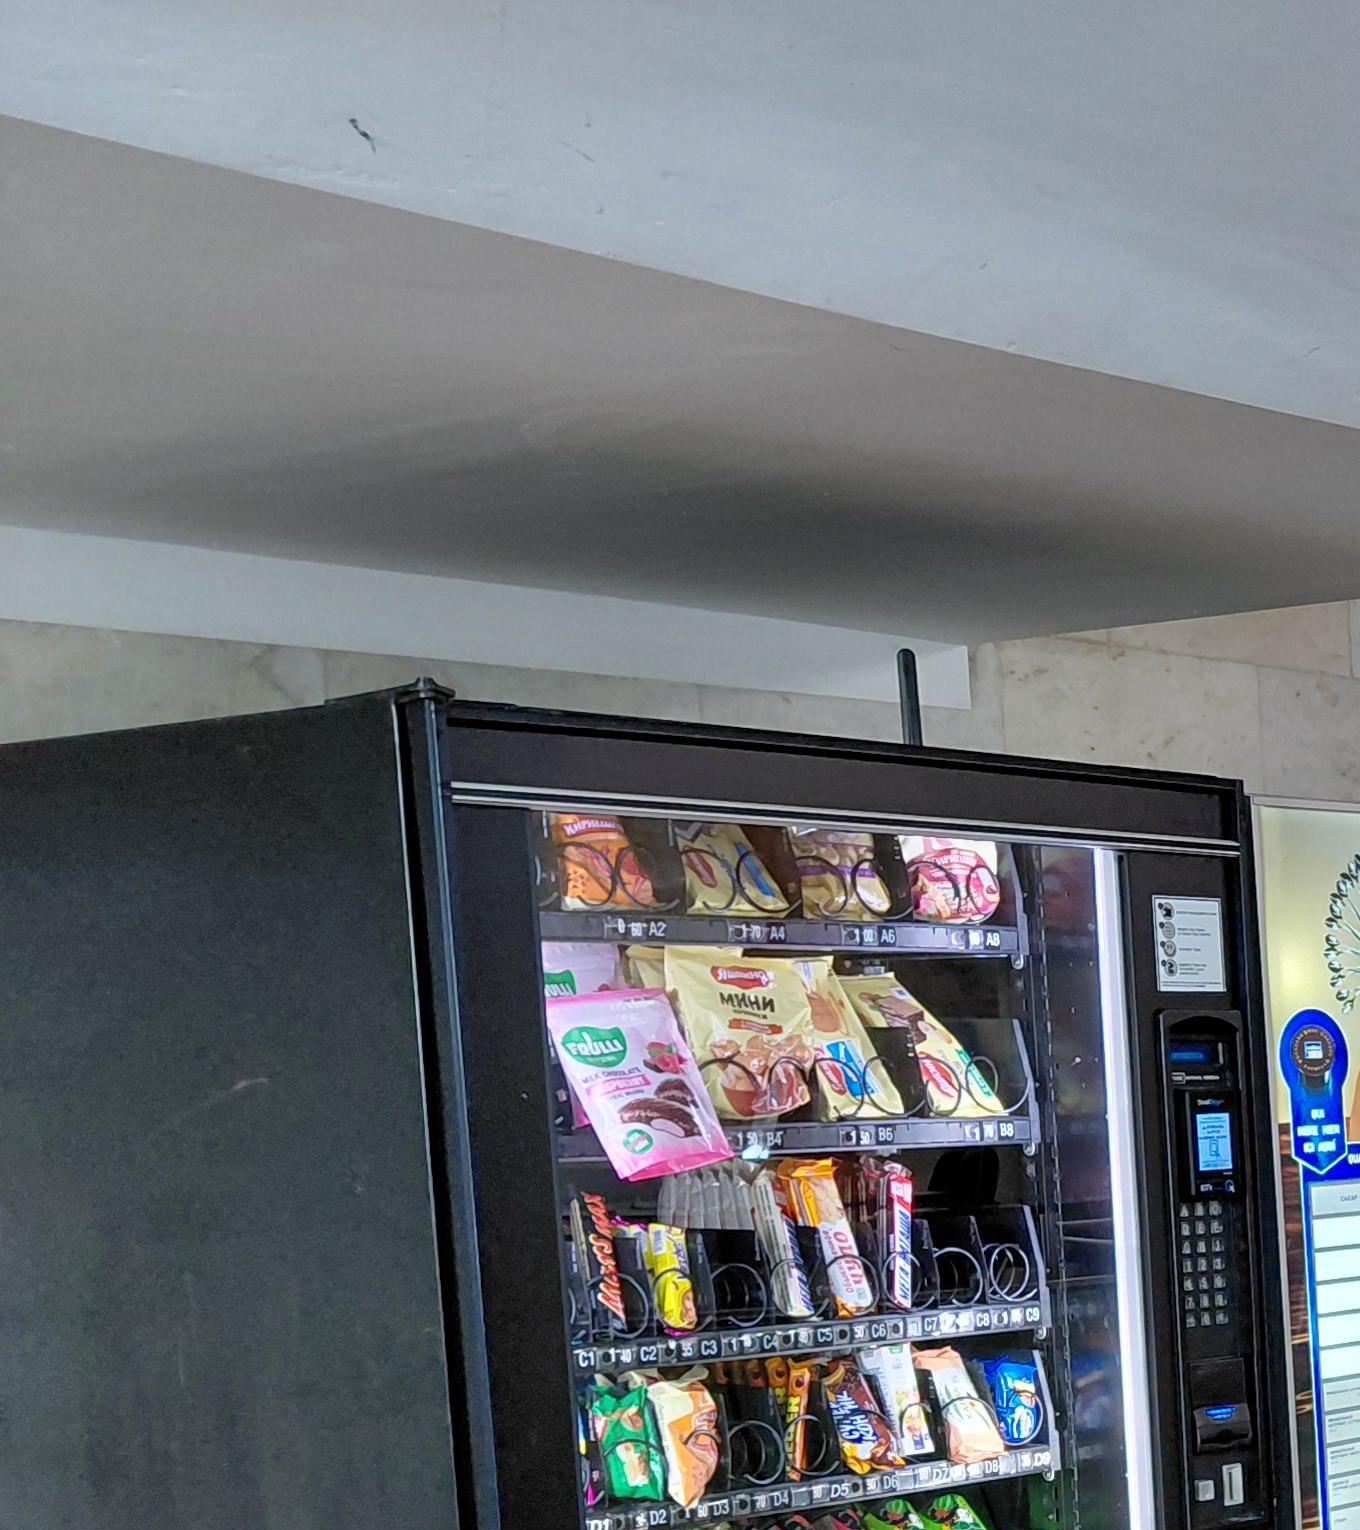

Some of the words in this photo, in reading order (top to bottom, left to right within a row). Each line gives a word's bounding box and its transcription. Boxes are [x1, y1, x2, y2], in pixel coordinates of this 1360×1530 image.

[649, 921, 667, 937] A2
[770, 925, 786, 940] A4
[880, 929, 896, 943] A6
[544, 982, 573, 998] ULLI
[719, 991, 776, 1013] МИНИ
[878, 1127, 894, 1141] B6
[1000, 1122, 1015, 1137] B8
[766, 1131, 784, 1145] B4
[976, 1313, 990, 1326] C8
[1025, 1308, 1040, 1321] C9
[871, 1324, 886, 1337] C6
[925, 1319, 937, 1331] C7
[763, 1335, 778, 1349] C4
[817, 1329, 833, 1342] C5
[640, 1347, 657, 1361] C2
[701, 1341, 718, 1355] C3
[579, 1352, 595, 1367] C1
[835, 1389, 879, 1446] КОНИК
[1033, 1451, 1051, 1466] D9
[985, 1461, 998, 1474] D8
[883, 1476, 898, 1489] D6
[831, 1485, 851, 1497] D5
[773, 1492, 789, 1507] D4
[713, 1502, 730, 1516] D3
[650, 1510, 667, 1525] D2
